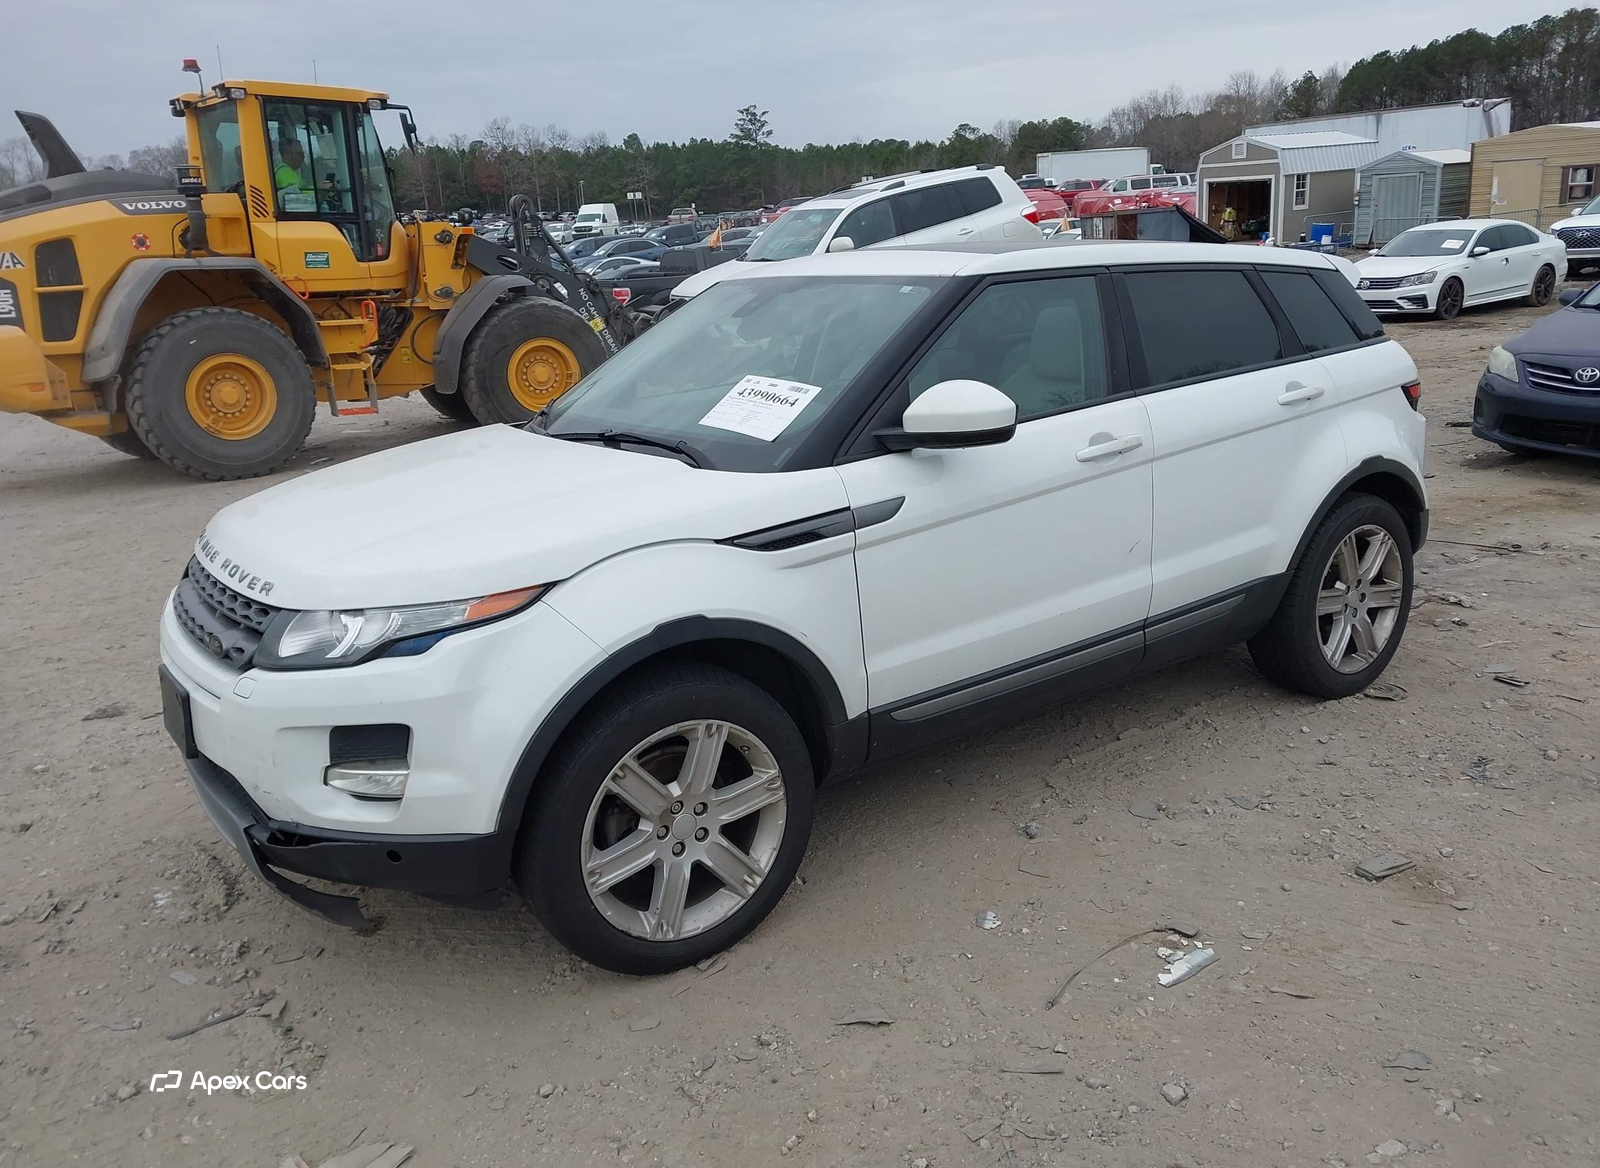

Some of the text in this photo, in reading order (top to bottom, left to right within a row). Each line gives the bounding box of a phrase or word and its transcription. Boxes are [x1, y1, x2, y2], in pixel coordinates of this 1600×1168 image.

[121, 200, 187, 210] VOLVO
[578, 288, 589, 300] NO
[736, 387, 800, 408] 43990664
[220, 558, 275, 597] ROVER
